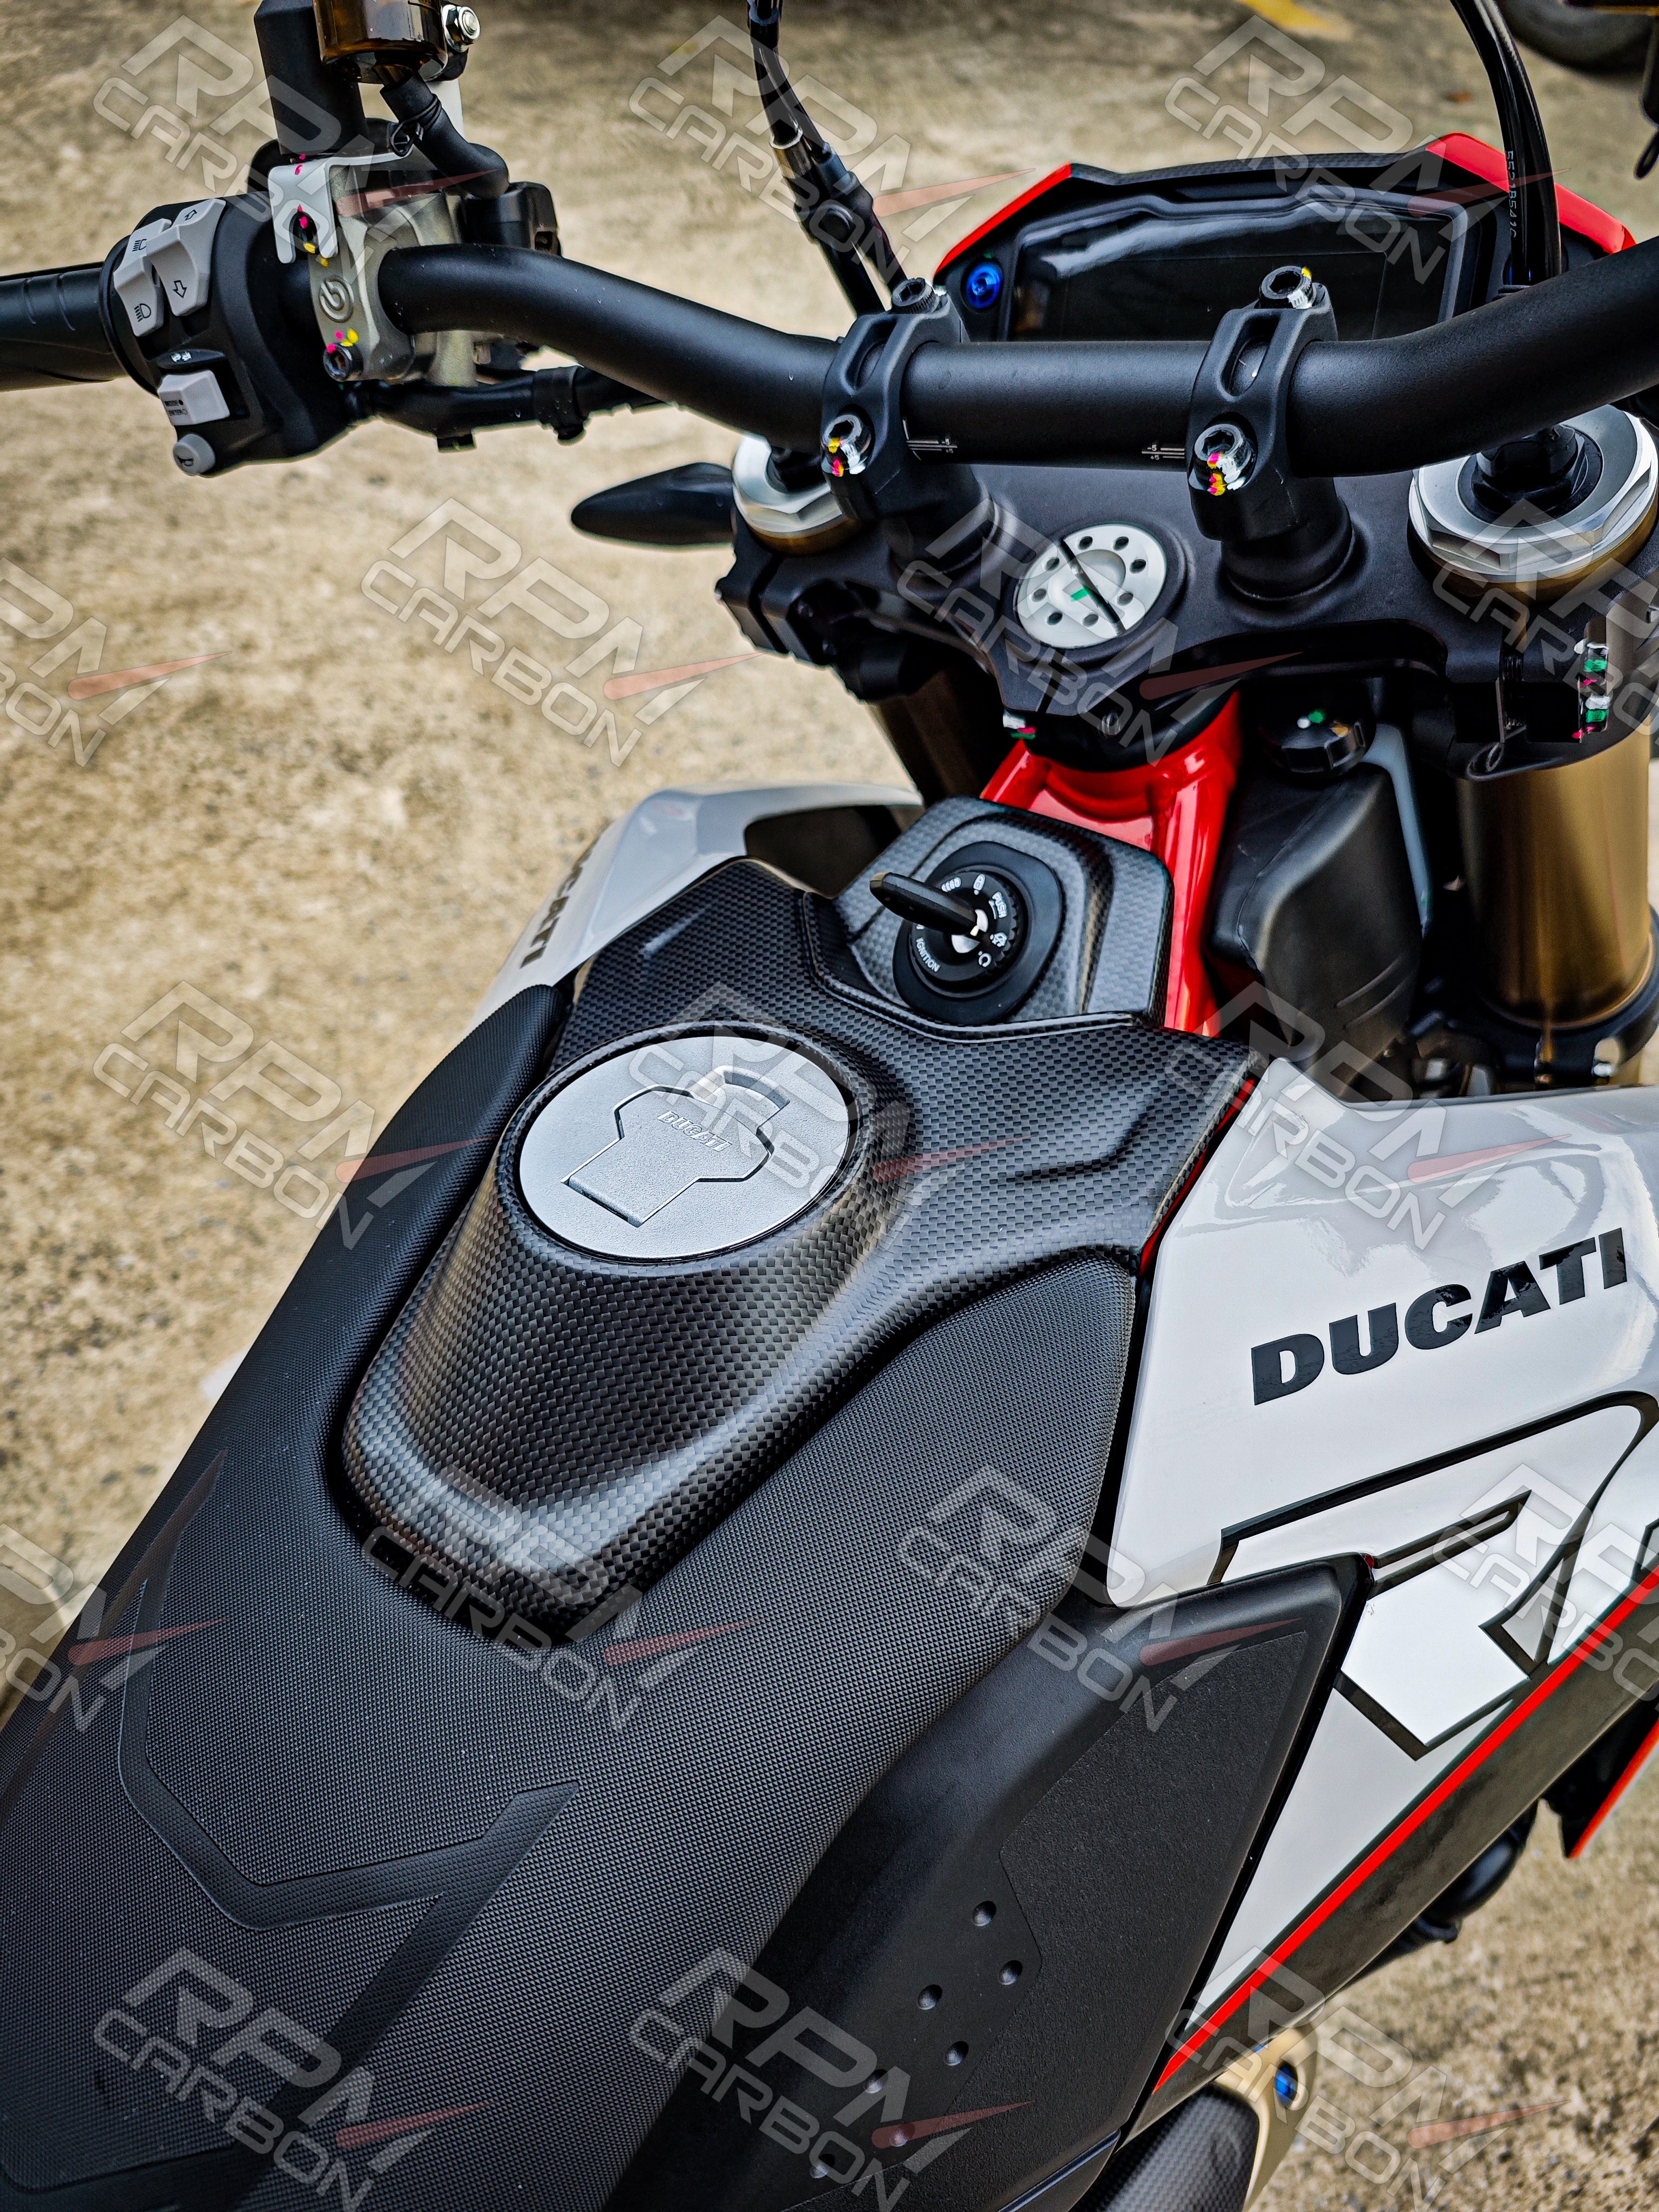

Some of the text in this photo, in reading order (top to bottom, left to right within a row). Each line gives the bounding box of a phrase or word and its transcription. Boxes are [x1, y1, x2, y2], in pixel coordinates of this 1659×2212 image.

[992, 891, 1008, 919] PUSH
[916, 937, 941, 972] IGNITION
[656, 1110, 733, 1152] DUCATI
[1250, 1227, 1628, 1406] DUCATI
